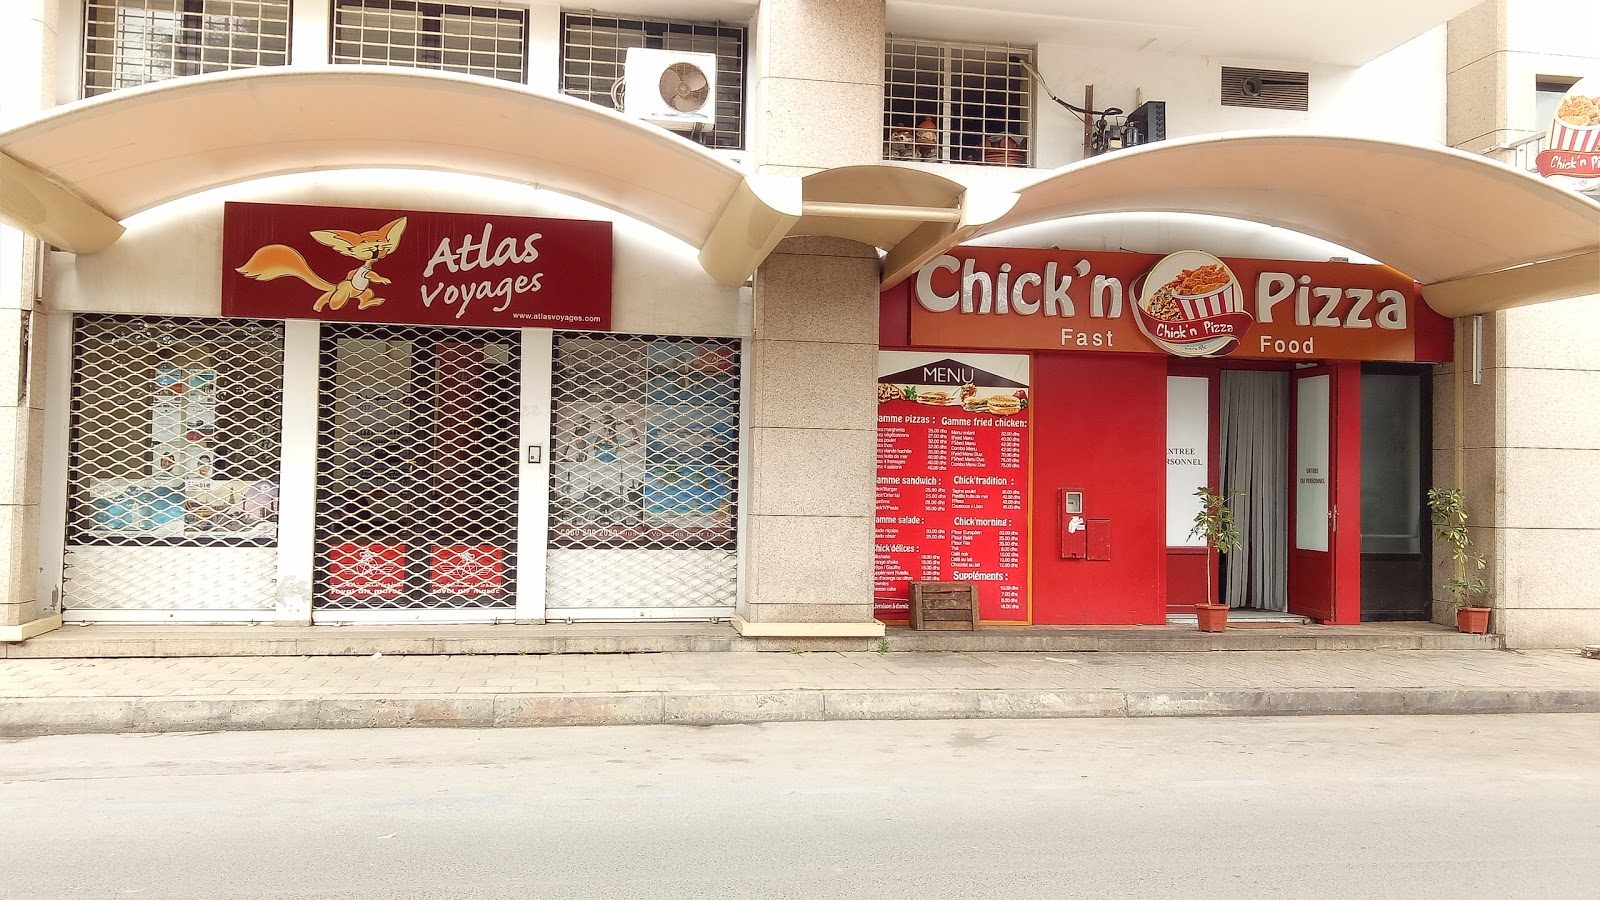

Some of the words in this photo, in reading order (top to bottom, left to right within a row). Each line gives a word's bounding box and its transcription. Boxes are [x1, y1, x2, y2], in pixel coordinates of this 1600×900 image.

[1550, 155, 1587, 170] Chick'n
[423, 222, 543, 278] Atlas
[915, 254, 1123, 319] Chick'n
[1255, 271, 1407, 330] Pizza
[513, 312, 601, 323] www.atlasvoyages.com
[1156, 323, 1197, 339] Chick'n
[1203, 320, 1234, 335] Pizza
[1060, 328, 1114, 347] Fast
[1259, 335, 1315, 354] Food
[923, 367, 974, 384] MENU
[878, 415, 903, 423] amme
[904, 414, 930, 424] pizzas
[941, 417, 972, 426] Gamme
[973, 417, 993, 427] fried
[995, 418, 1027, 428] chicken:
[877, 477, 900, 485] amme
[901, 476, 937, 485] sandwich
[954, 476, 1007, 485] Chick'tradition
[898, 516, 920, 524] salade
[954, 517, 1007, 526] Chick'morning
[875, 544, 915, 552] hick'délices
[953, 571, 1003, 581] Suppléments
